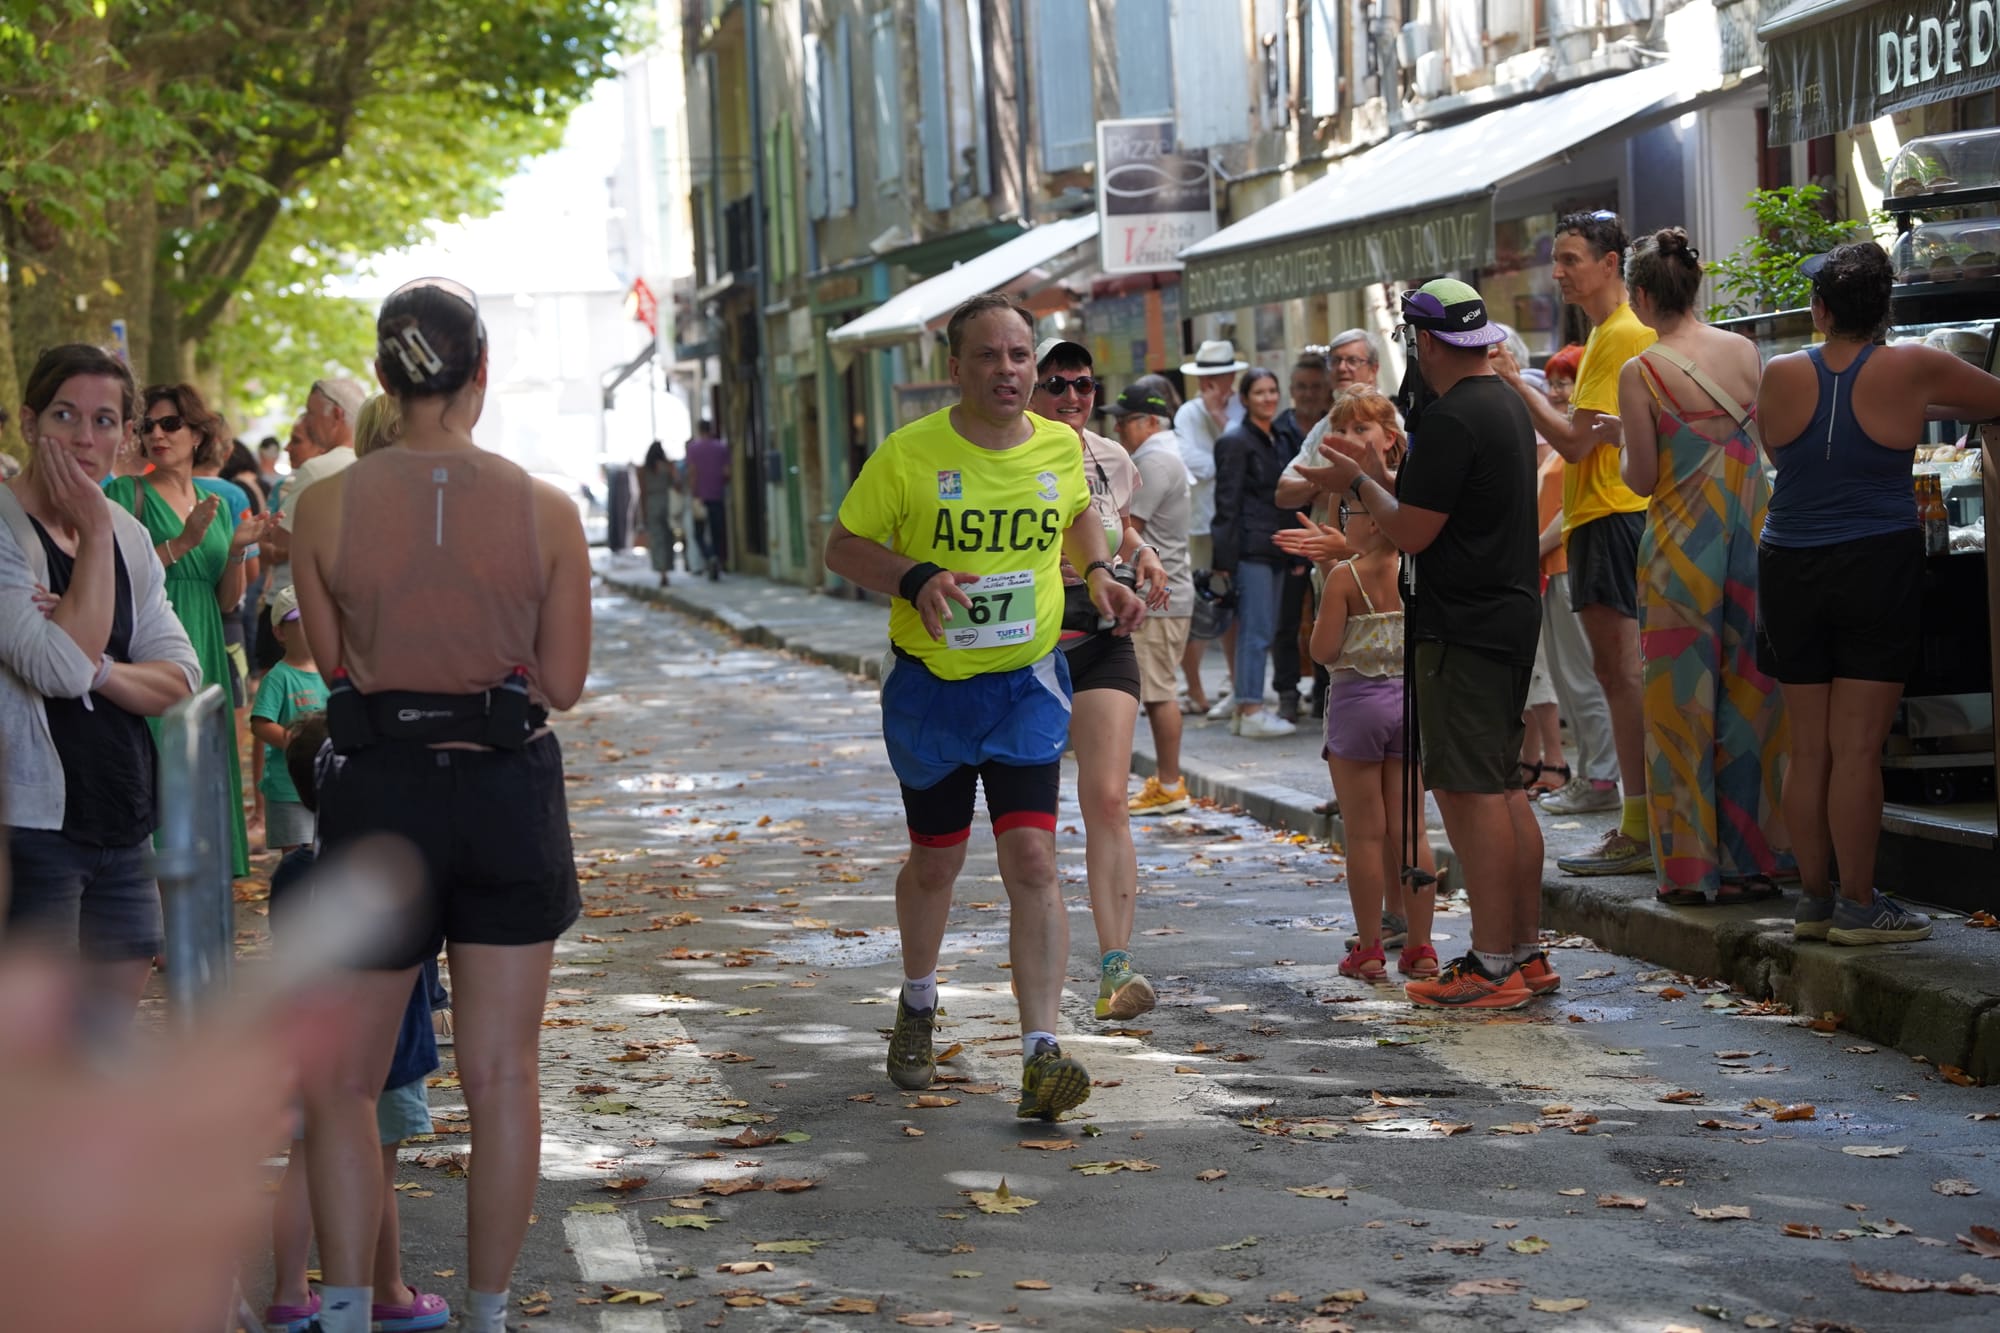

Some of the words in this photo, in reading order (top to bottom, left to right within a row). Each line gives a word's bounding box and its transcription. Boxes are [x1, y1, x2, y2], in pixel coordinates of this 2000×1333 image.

[1879, 1, 1962, 95] DÉDÉ
[1969, 0, 2000, 68] D
[1106, 133, 1178, 161] Pizze
[1188, 262, 1248, 310] BOUCHERIE
[1409, 212, 1479, 269] ROUME
[932, 508, 1059, 552] ASICS
[968, 592, 1013, 625] 67
